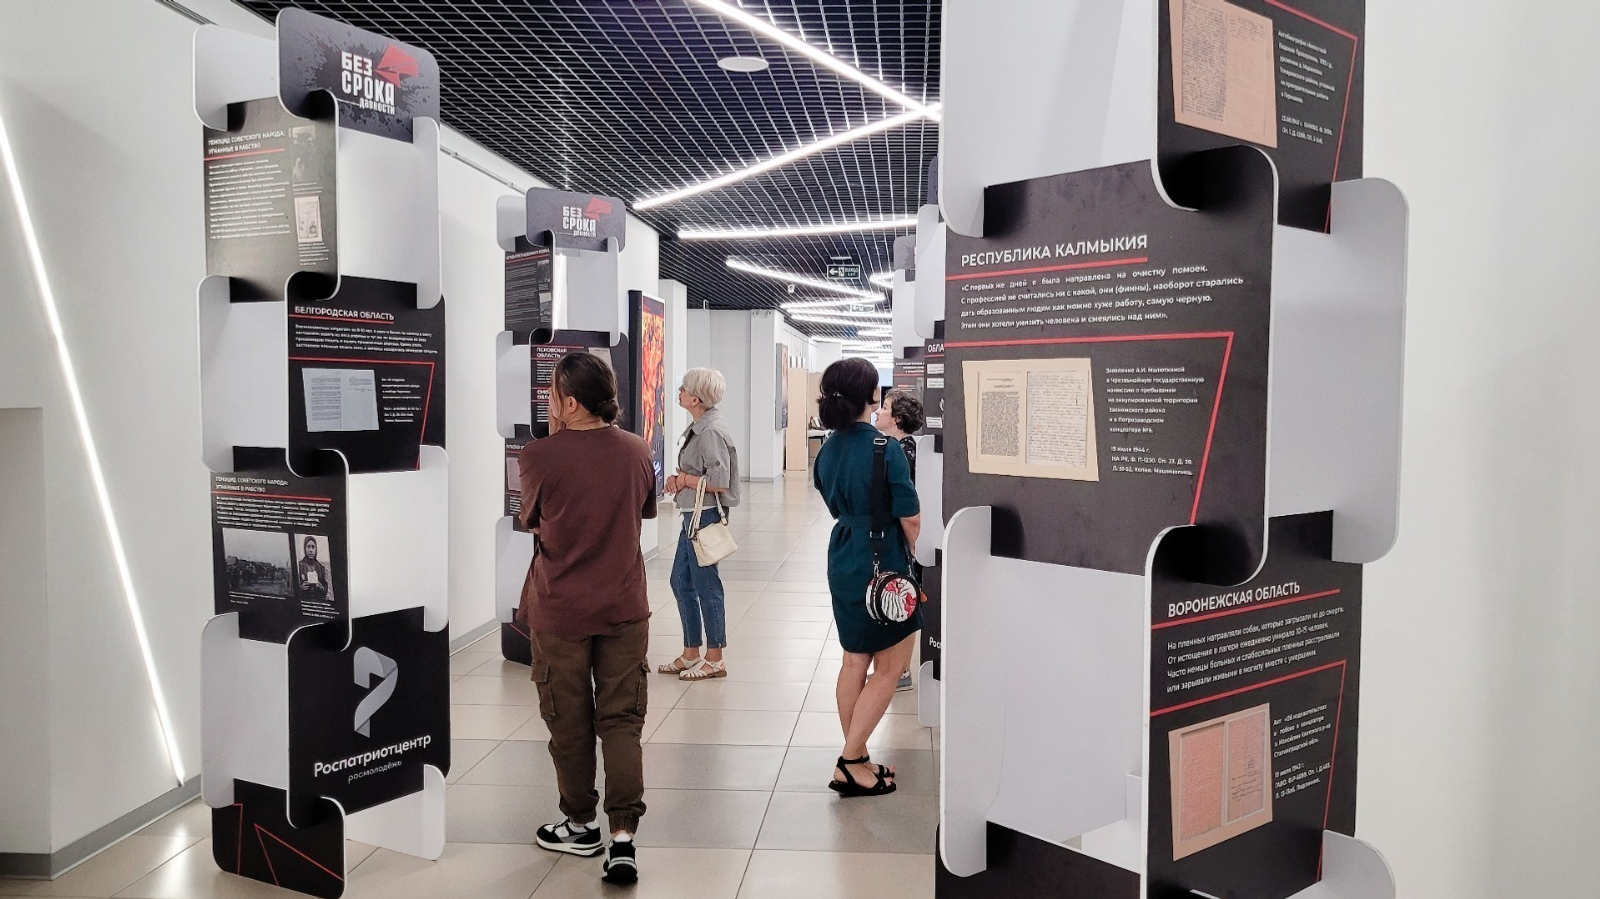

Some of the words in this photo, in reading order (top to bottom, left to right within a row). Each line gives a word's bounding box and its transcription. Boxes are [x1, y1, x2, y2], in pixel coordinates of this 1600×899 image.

[342, 51, 372, 77] БЕЗ
[342, 70, 394, 106] СРОКА
[562, 206, 582, 218] БЕЗ
[562, 216, 596, 232] СРОКА
[961, 246, 1051, 268] РЕСПУБЛИКА
[1055, 234, 1148, 258] КАЛМЫКИЯ
[966, 294, 1006, 305] профессией
[1018, 292, 1054, 300] считались
[1056, 290, 1065, 298] ни
[1073, 286, 1097, 297] какой,
[1115, 283, 1151, 294] (финны),
[1153, 280, 1194, 291] наоборот
[1196, 277, 1244, 288] старались
[970, 284, 994, 292] первых
[1010, 278, 1027, 288] дней
[1066, 273, 1111, 284] направлена
[1132, 268, 1166, 278] очистку
[1172, 265, 1208, 274] помоек.
[294, 306, 358, 319] БЕЛГОРОДСКАЯ
[360, 311, 394, 320] ОБЛАСТЬ
[976, 307, 1025, 316] образованным
[1026, 305, 1051, 313] людям
[1052, 304, 1066, 312] как
[1067, 302, 1092, 310] можно
[1094, 300, 1113, 310] хуже
[1114, 298, 1145, 308] работу,
[1146, 297, 1174, 306] самую
[1176, 295, 1212, 304] черную.
[960, 322, 976, 330] Этим
[1016, 319, 1044, 328] унизить
[1045, 316, 1080, 325] человека
[1088, 314, 1125, 323] смеялись
[1127, 313, 1142, 321] над
[1168, 589, 1253, 618] ВОРОНЕЖСКАЯ
[1255, 581, 1300, 601] ОБЛАСТЬ
[1168, 642, 1176, 651] На
[1178, 636, 1206, 649] пленных
[1206, 629, 1242, 643] натравляли
[1242, 624, 1260, 634] собак,
[1261, 620, 1284, 631] которые
[1284, 613, 1311, 626] загрызали
[1167, 669, 1186, 678] Часто
[1187, 663, 1209, 674] немцы
[1210, 656, 1235, 669] больных
[1281, 640, 1304, 651] пленных
[1168, 656, 1176, 664] От
[1178, 648, 1212, 662] истощения
[1218, 642, 1239, 654] лагере
[1240, 635, 1271, 648] ежедневно
[1272, 630, 1295, 643] умирало
[1166, 684, 1180, 694] или
[1181, 676, 1212, 690] зарывали
[1212, 669, 1238, 682] живыми
[1243, 662, 1264, 674] могилу
[1264, 657, 1283, 668] вместе
[314, 734, 432, 778] Роспатриотцентр
[348, 760, 402, 784] росмолодёжь
